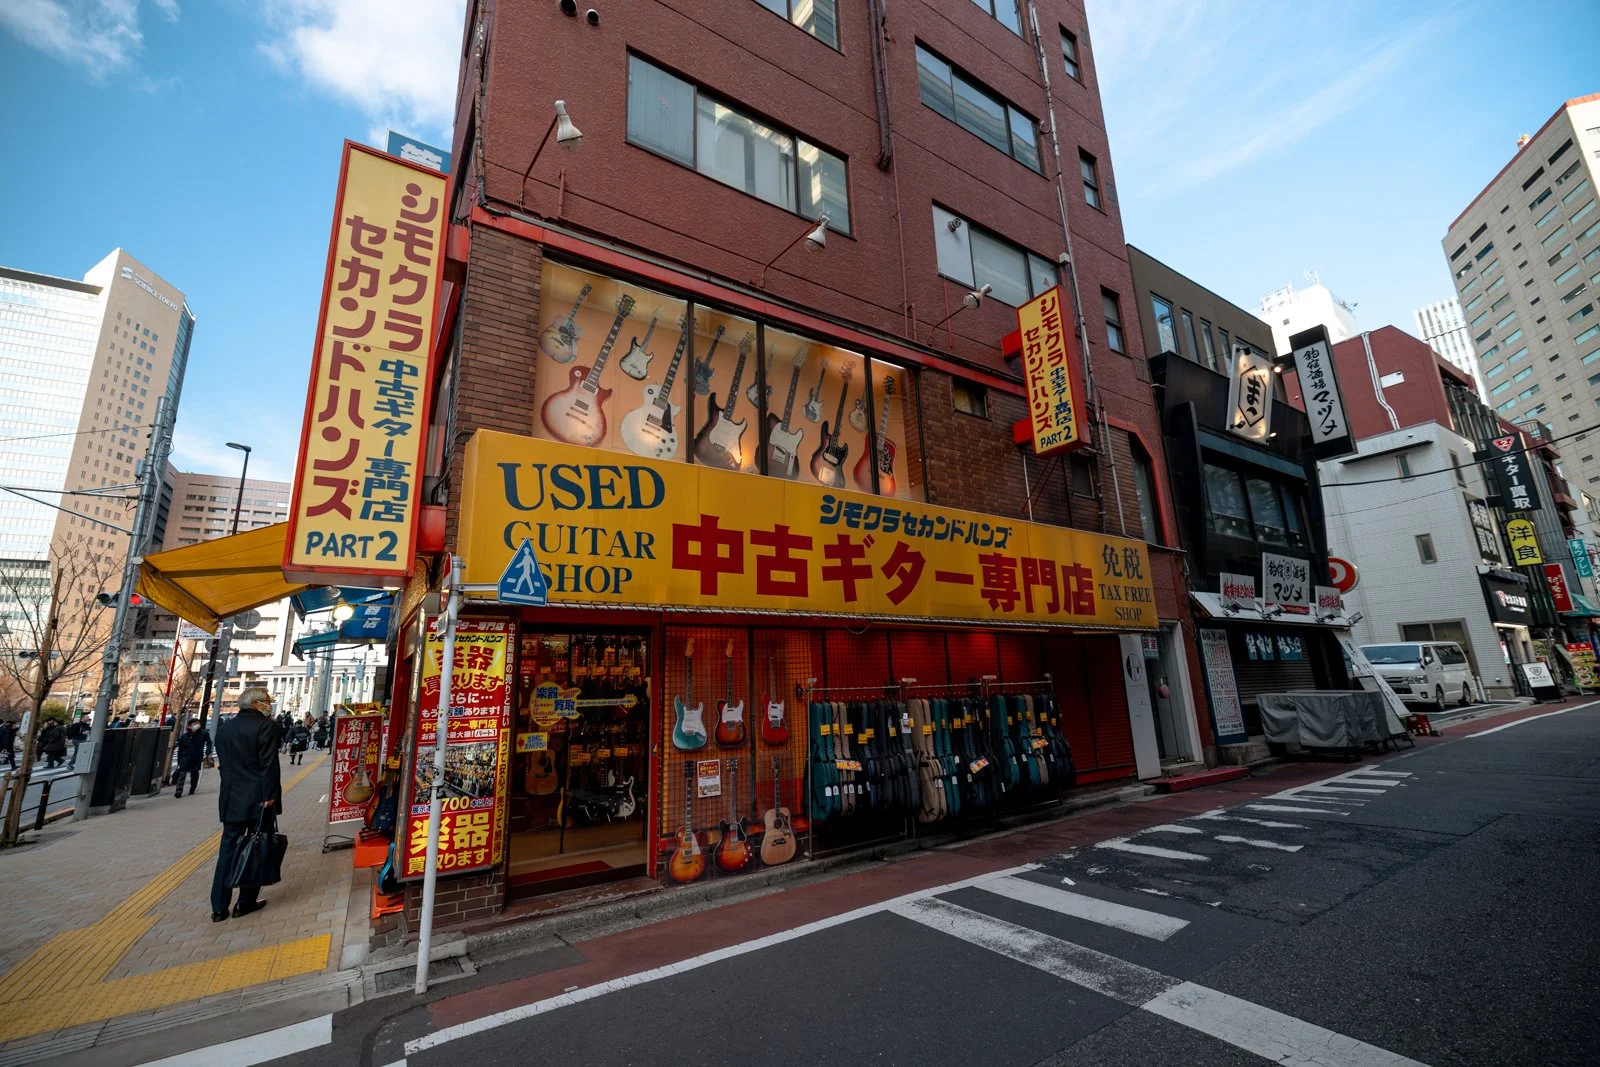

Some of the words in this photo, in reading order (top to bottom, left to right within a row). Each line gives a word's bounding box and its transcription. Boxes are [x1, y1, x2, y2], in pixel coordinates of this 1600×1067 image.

[384, 182, 439, 352] シモクラ
[1040, 296, 1064, 367] シモクラ
[306, 215, 387, 521] セカンドハンズ
[1024, 326, 1052, 434] セカンドハンズ
[1050, 366, 1072, 427] 中古ギター専門店
[359, 360, 419, 523] 中古ギター専門店
[497, 462, 665, 511] USED
[503, 520, 656, 560] GUITAR
[819, 494, 1013, 550] シモクラセカンドハンズ
[1510, 525, 1540, 560] 洋食
[538, 561, 633, 594] SHOP
[672, 513, 1096, 617] 中古ギター専門店
[1101, 543, 1144, 582] 免税
[1098, 583, 1122, 602] TAX
[1123, 585, 1153, 603] FREE
[1115, 606, 1142, 622] SHOP
[347, 719, 362, 745] 楽器
[410, 812, 490, 855] 楽器
